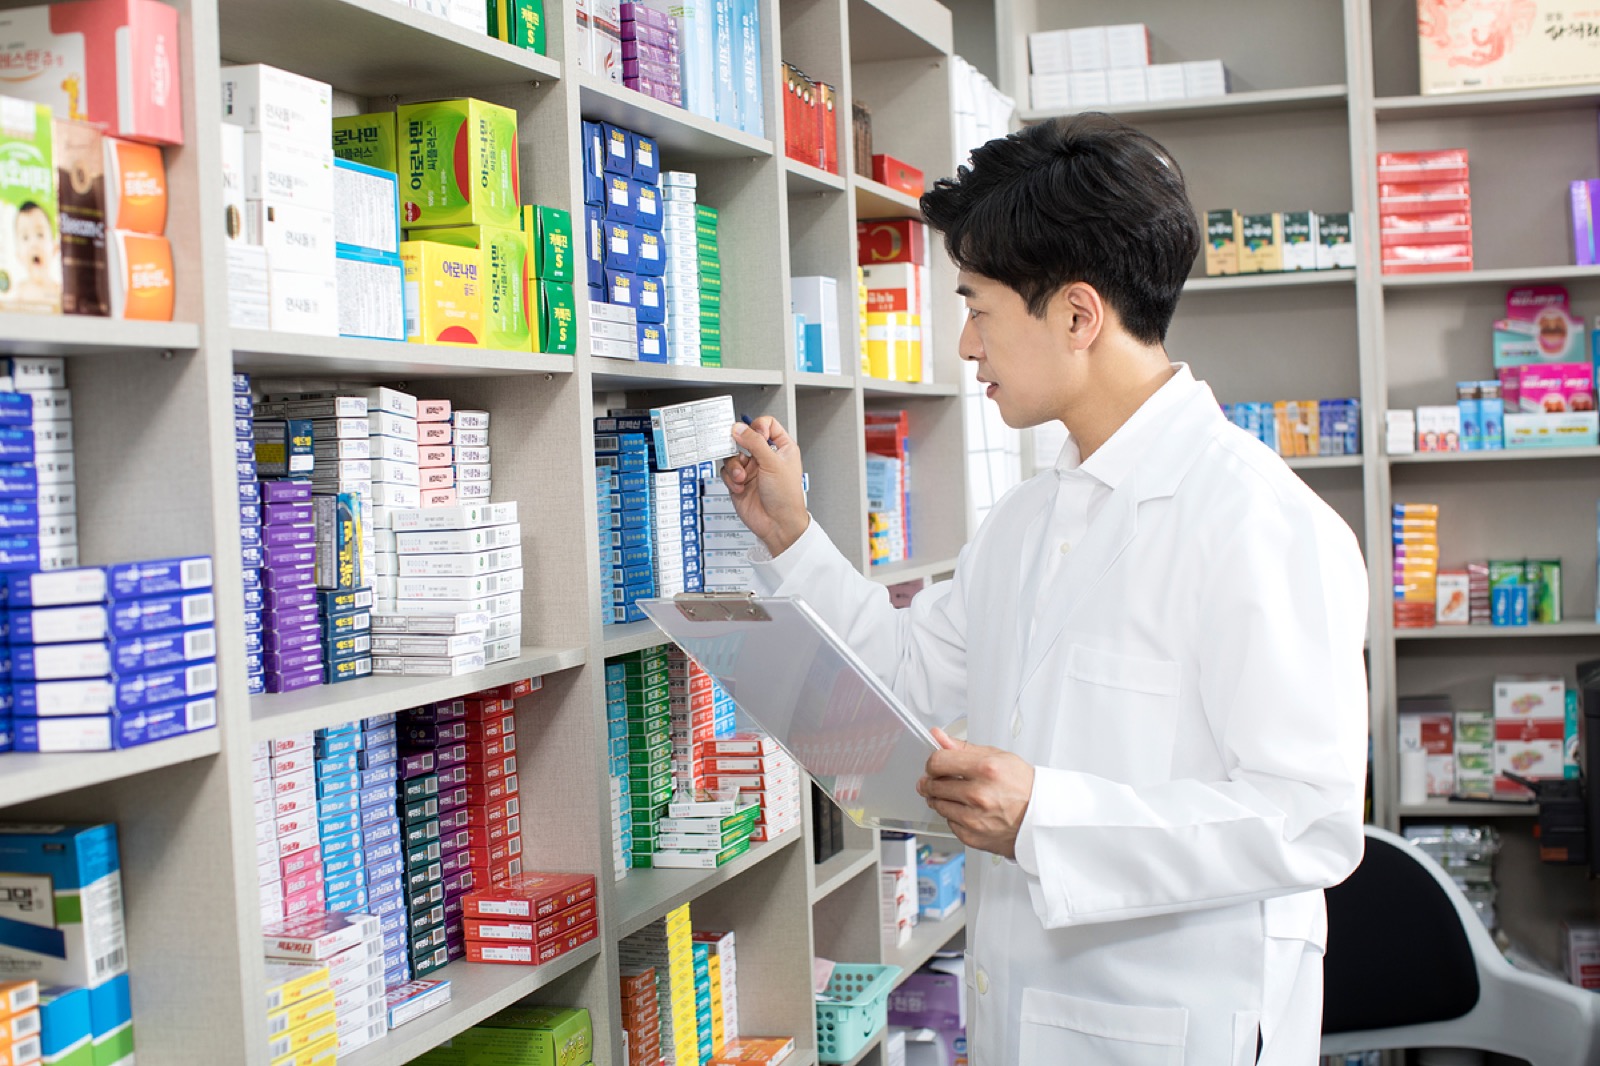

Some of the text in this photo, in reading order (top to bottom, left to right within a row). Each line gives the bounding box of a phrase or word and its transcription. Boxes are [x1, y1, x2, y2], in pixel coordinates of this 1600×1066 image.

[331, 127, 378, 146] 로나민
[408, 120, 425, 191] 아로나민
[426, 126, 438, 171] 씨플러스
[479, 119, 490, 189] 아로나민
[442, 260, 478, 281] 아로나민
[491, 244, 501, 314] 아로나민
